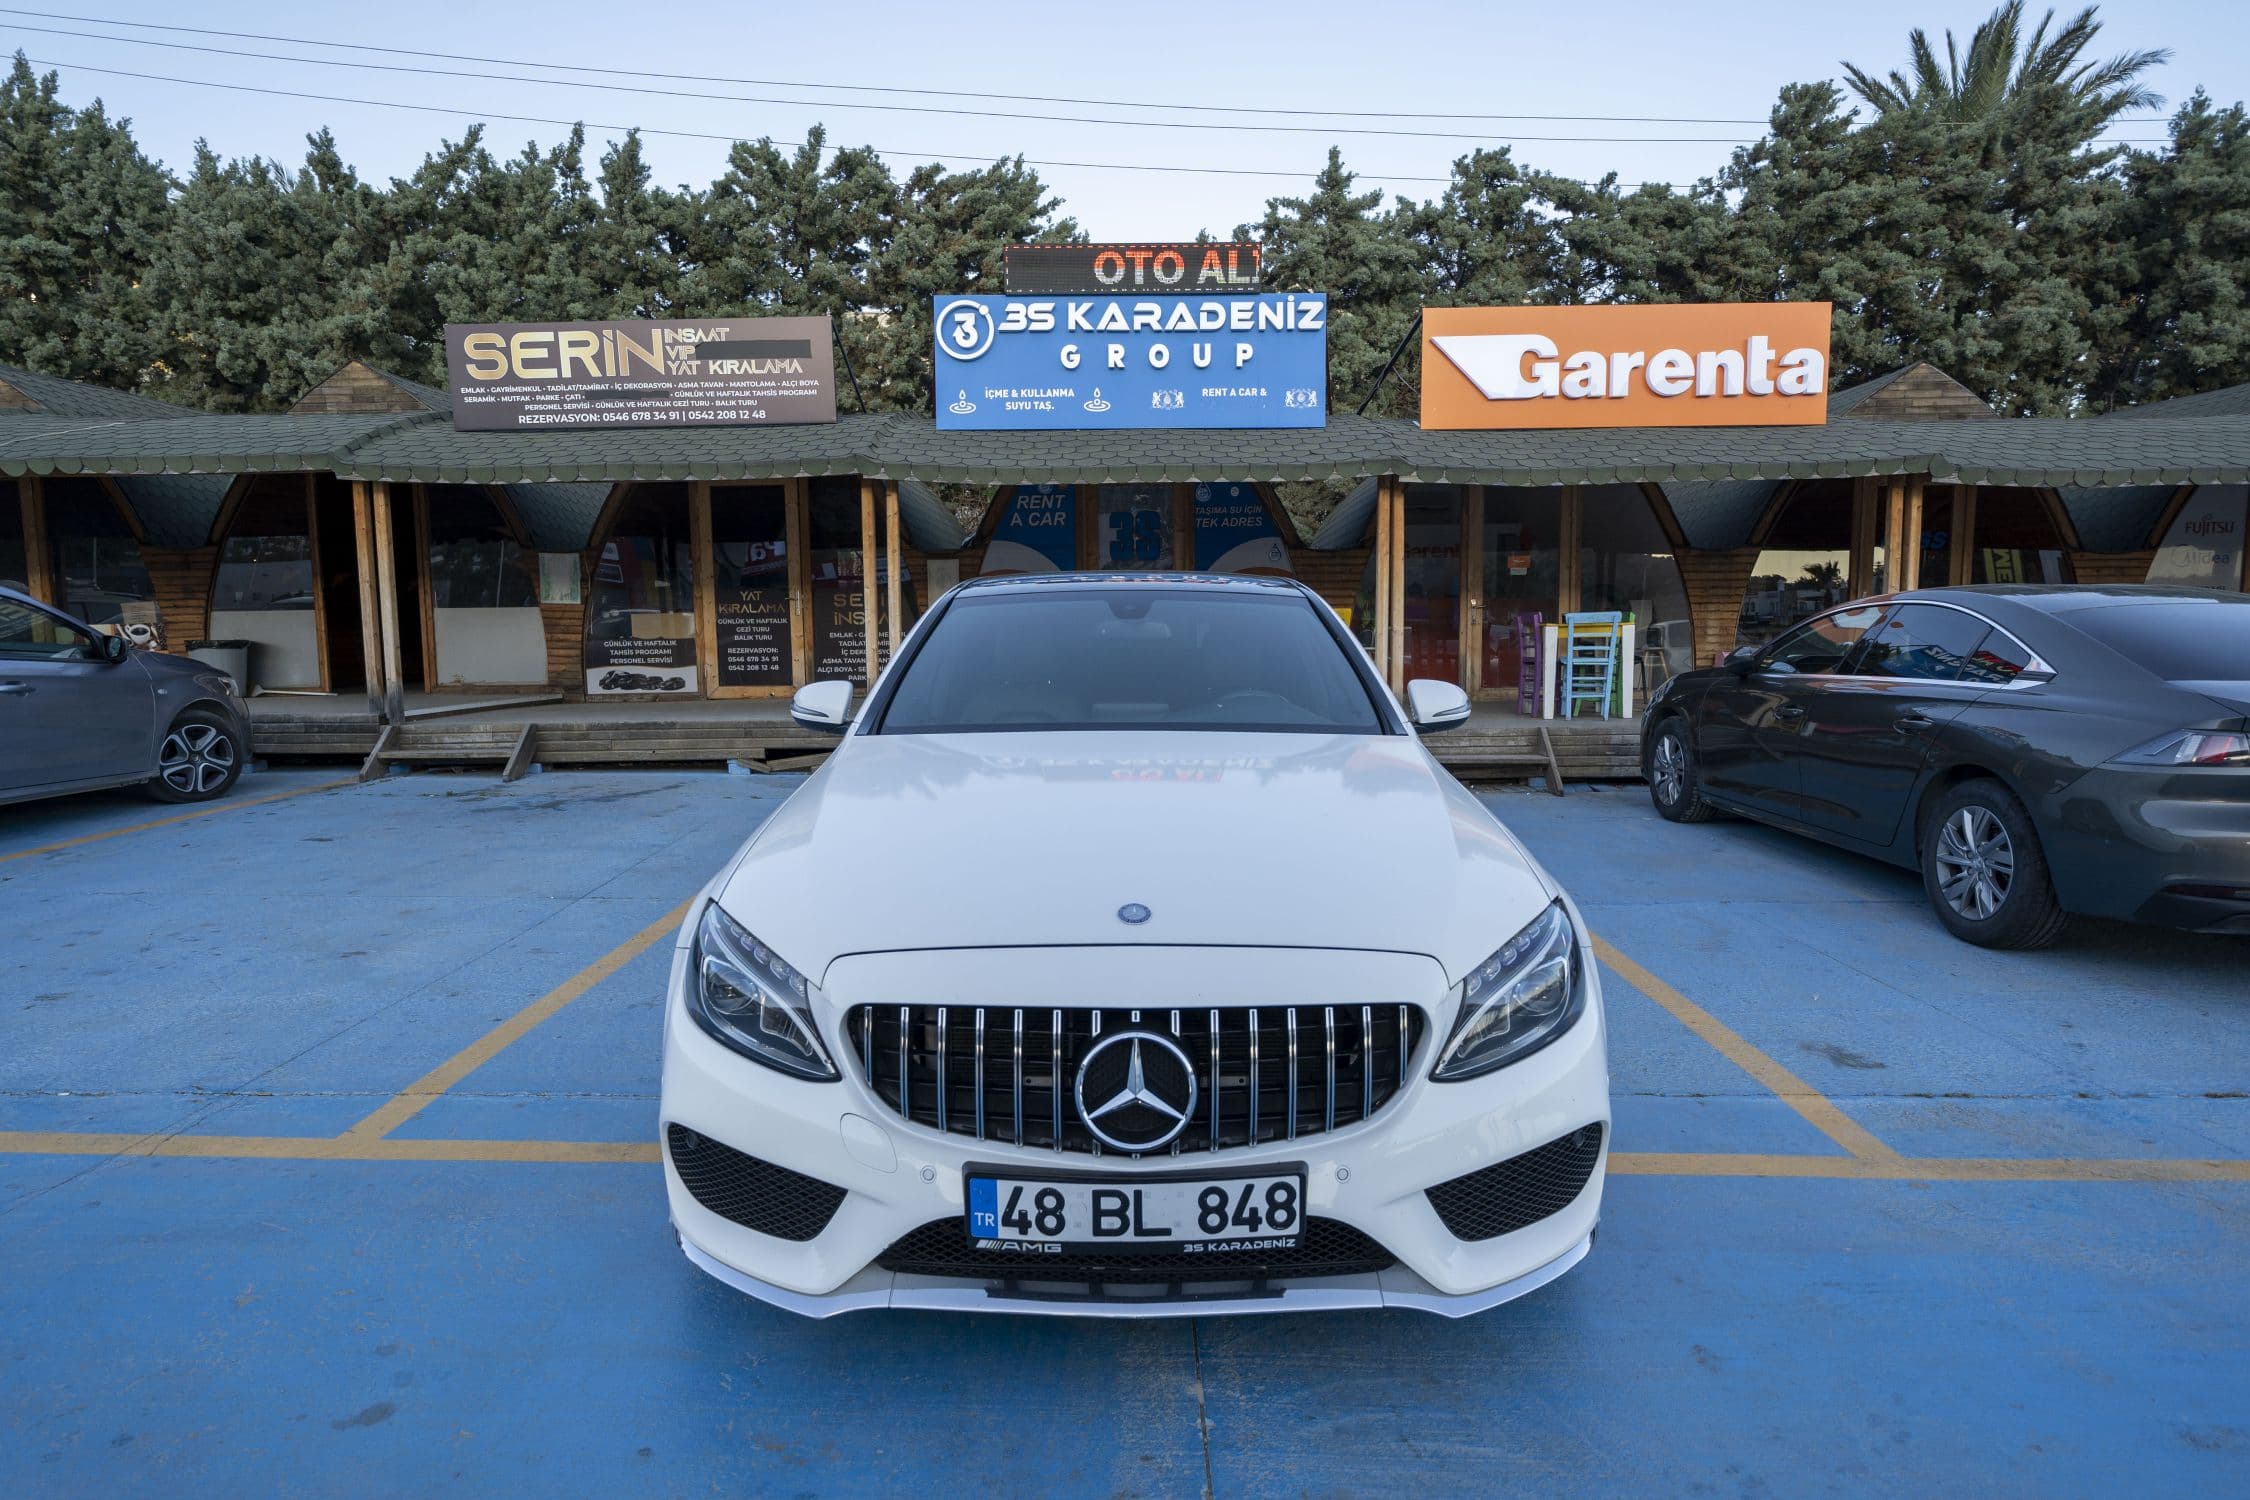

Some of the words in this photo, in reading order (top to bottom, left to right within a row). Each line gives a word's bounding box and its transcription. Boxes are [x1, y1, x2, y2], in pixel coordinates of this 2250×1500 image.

[1093, 249, 1185, 285] OTO
[998, 302, 1056, 331] 3S
[1067, 295, 1324, 331] KARADENİZ
[464, 329, 665, 380] SERİN
[1060, 343, 1254, 369] GROUP
[667, 361, 700, 375] YAT
[709, 359, 803, 374] KIRALAMA
[1430, 334, 1824, 399] Garenta
[624, 382, 672, 391] DEKORASYON
[781, 380, 798, 388] ALÇI
[1202, 387, 1226, 398] RENT
[1227, 387, 1236, 398] A
[1238, 387, 1258, 398] CAR
[1260, 387, 1267, 397] &
[464, 395, 496, 403] SERAMİK
[565, 393, 581, 401] ÇATI
[674, 390, 704, 398] GÜNLÜK
[985, 386, 1008, 400] İÇME
[1010, 388, 1018, 398] &
[1020, 388, 1074, 398] KULLANMA
[524, 403, 562, 411] PERSONEL
[637, 400, 671, 408] HAFTALIK
[673, 399, 689, 407] GEZİ
[1005, 401, 1030, 411] SUYU
[1031, 400, 1055, 412] TAŞ.
[519, 414, 600, 424] REZERVASYON:
[603, 412, 629, 421] 0546
[632, 412, 651, 421] 678
[653, 412, 666, 420] 34
[669, 411, 680, 420] 91
[688, 411, 714, 420] 0542
[717, 410, 736, 419] 208
[739, 410, 750, 419] 12
[752, 410, 766, 419] 48
[1016, 494, 1066, 509] RENT
[1229, 505, 1242, 514] SU
[1009, 512, 1023, 527] A
[1028, 512, 1066, 526] CAR
[1196, 518, 1218, 528] TEK
[1221, 516, 1263, 528] ADRES
[1109, 511, 1160, 560] 3S
[739, 591, 763, 601] YAT
[603, 640, 632, 648] GÜNLÜK
[974, 1212, 995, 1227] TR
[1001, 1185, 1066, 1237] 48
[1091, 1189, 1172, 1237] BL
[1197, 1181, 1297, 1235] 848
[1002, 1241, 1062, 1253] AMG
[1183, 1243, 1204, 1253] 3S
[1208, 1237, 1296, 1252] KARADENİZ
